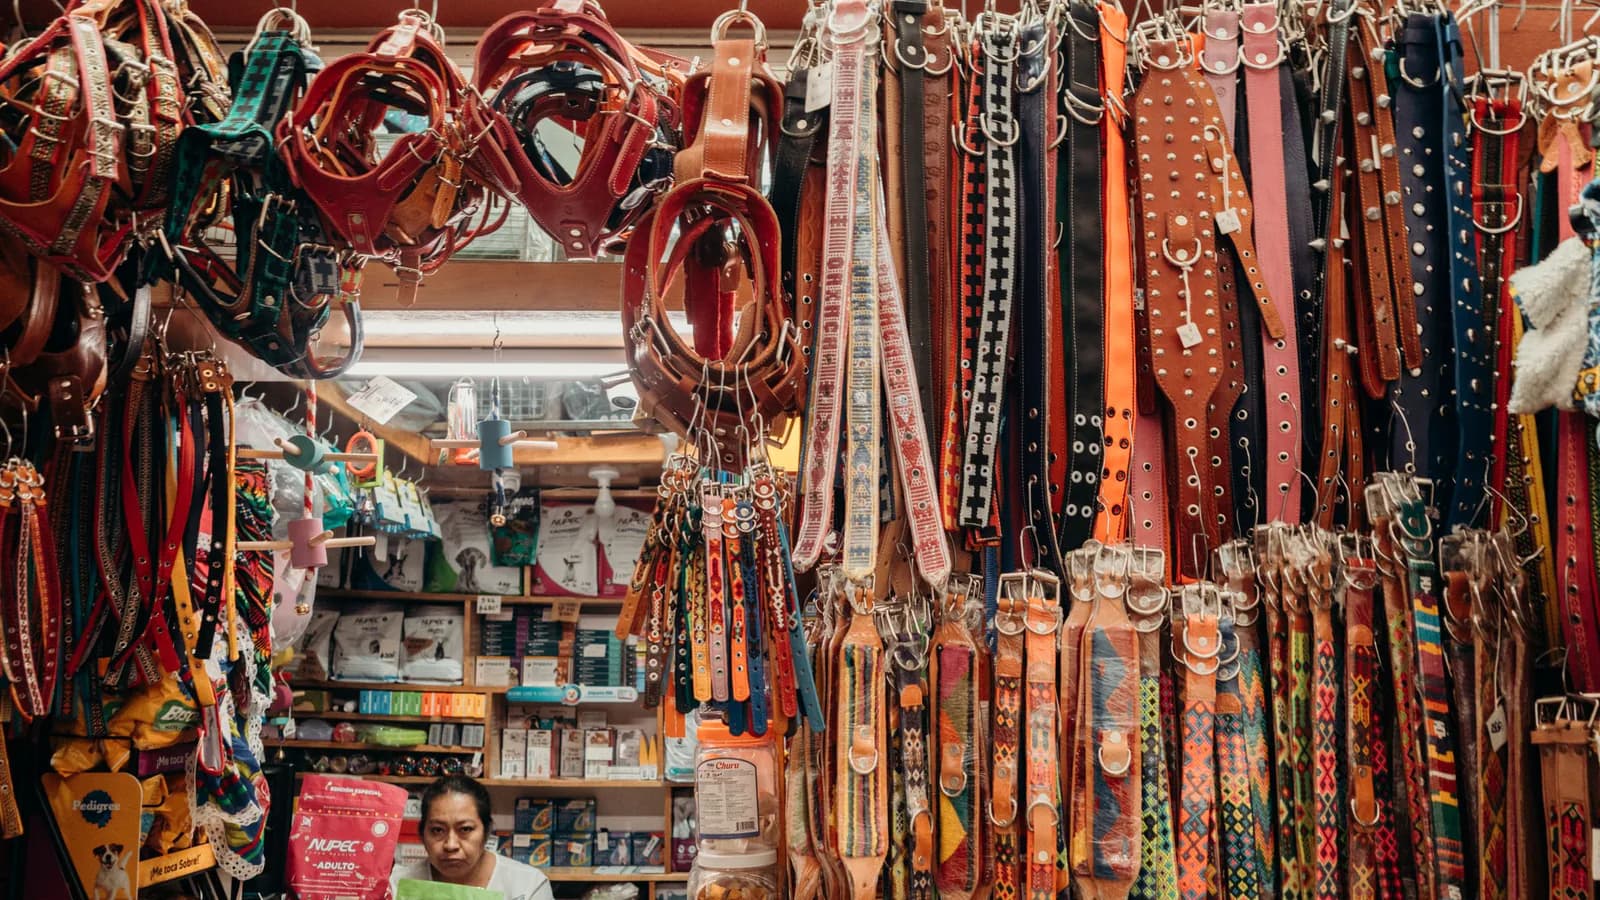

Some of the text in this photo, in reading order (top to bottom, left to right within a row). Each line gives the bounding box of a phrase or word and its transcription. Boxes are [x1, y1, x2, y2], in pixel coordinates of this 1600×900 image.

[551, 517, 583, 526] NUPEC
[72, 799, 121, 814] Pedigree
[308, 838, 360, 852] NUPEC
[164, 862, 178, 874] toca
